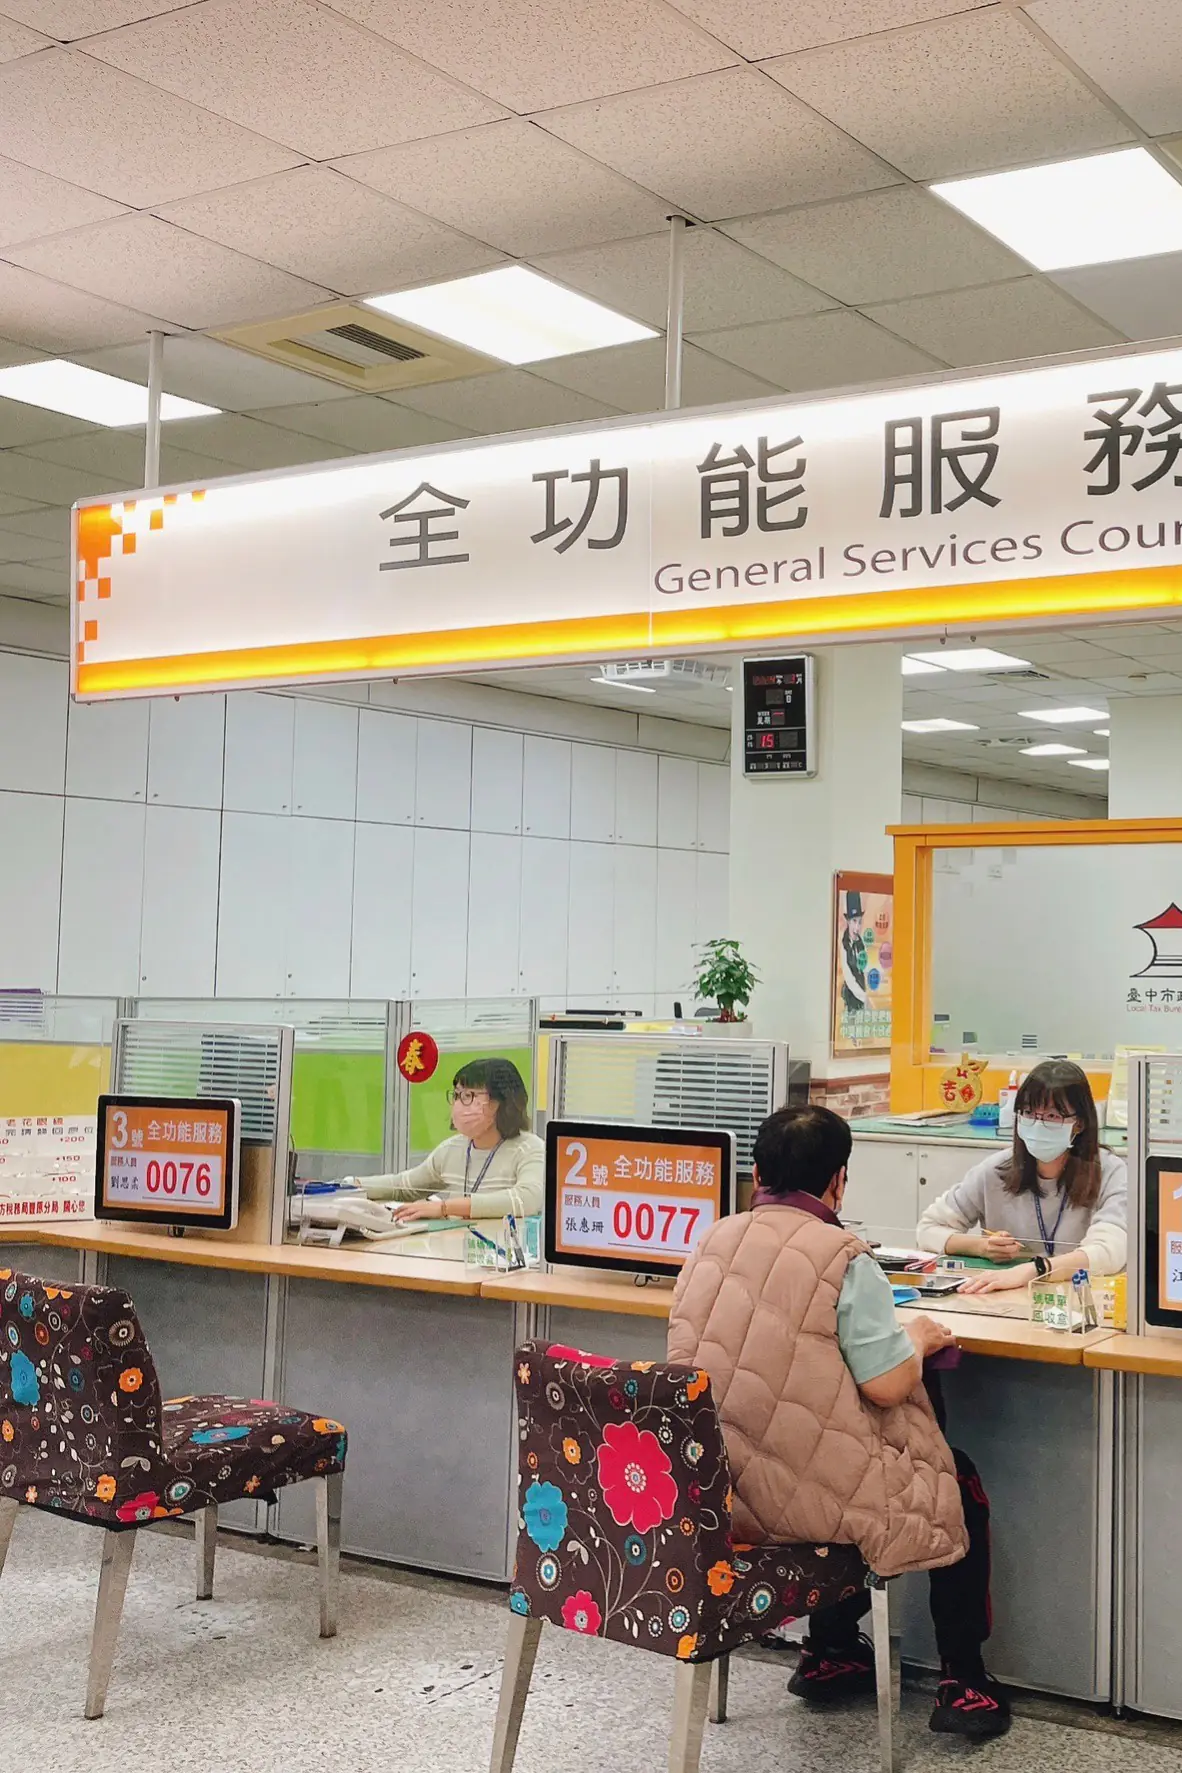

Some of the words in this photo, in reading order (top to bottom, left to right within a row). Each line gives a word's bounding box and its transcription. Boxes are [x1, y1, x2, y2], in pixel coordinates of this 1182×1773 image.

[654, 546, 826, 595] General
[842, 531, 1043, 578] Services
[761, 734, 774, 748] 15
[1126, 1003, 1146, 1012] Local
[1149, 1004, 1161, 1012] Tax
[111, 1110, 144, 1149] 3號
[147, 1120, 223, 1145] 全功能服務
[146, 1160, 212, 1197] 0076
[564, 1141, 609, 1187] 2號
[613, 1154, 716, 1187] 全功能服務
[564, 1193, 601, 1209] 服務人員
[613, 1200, 701, 1245] 0077
